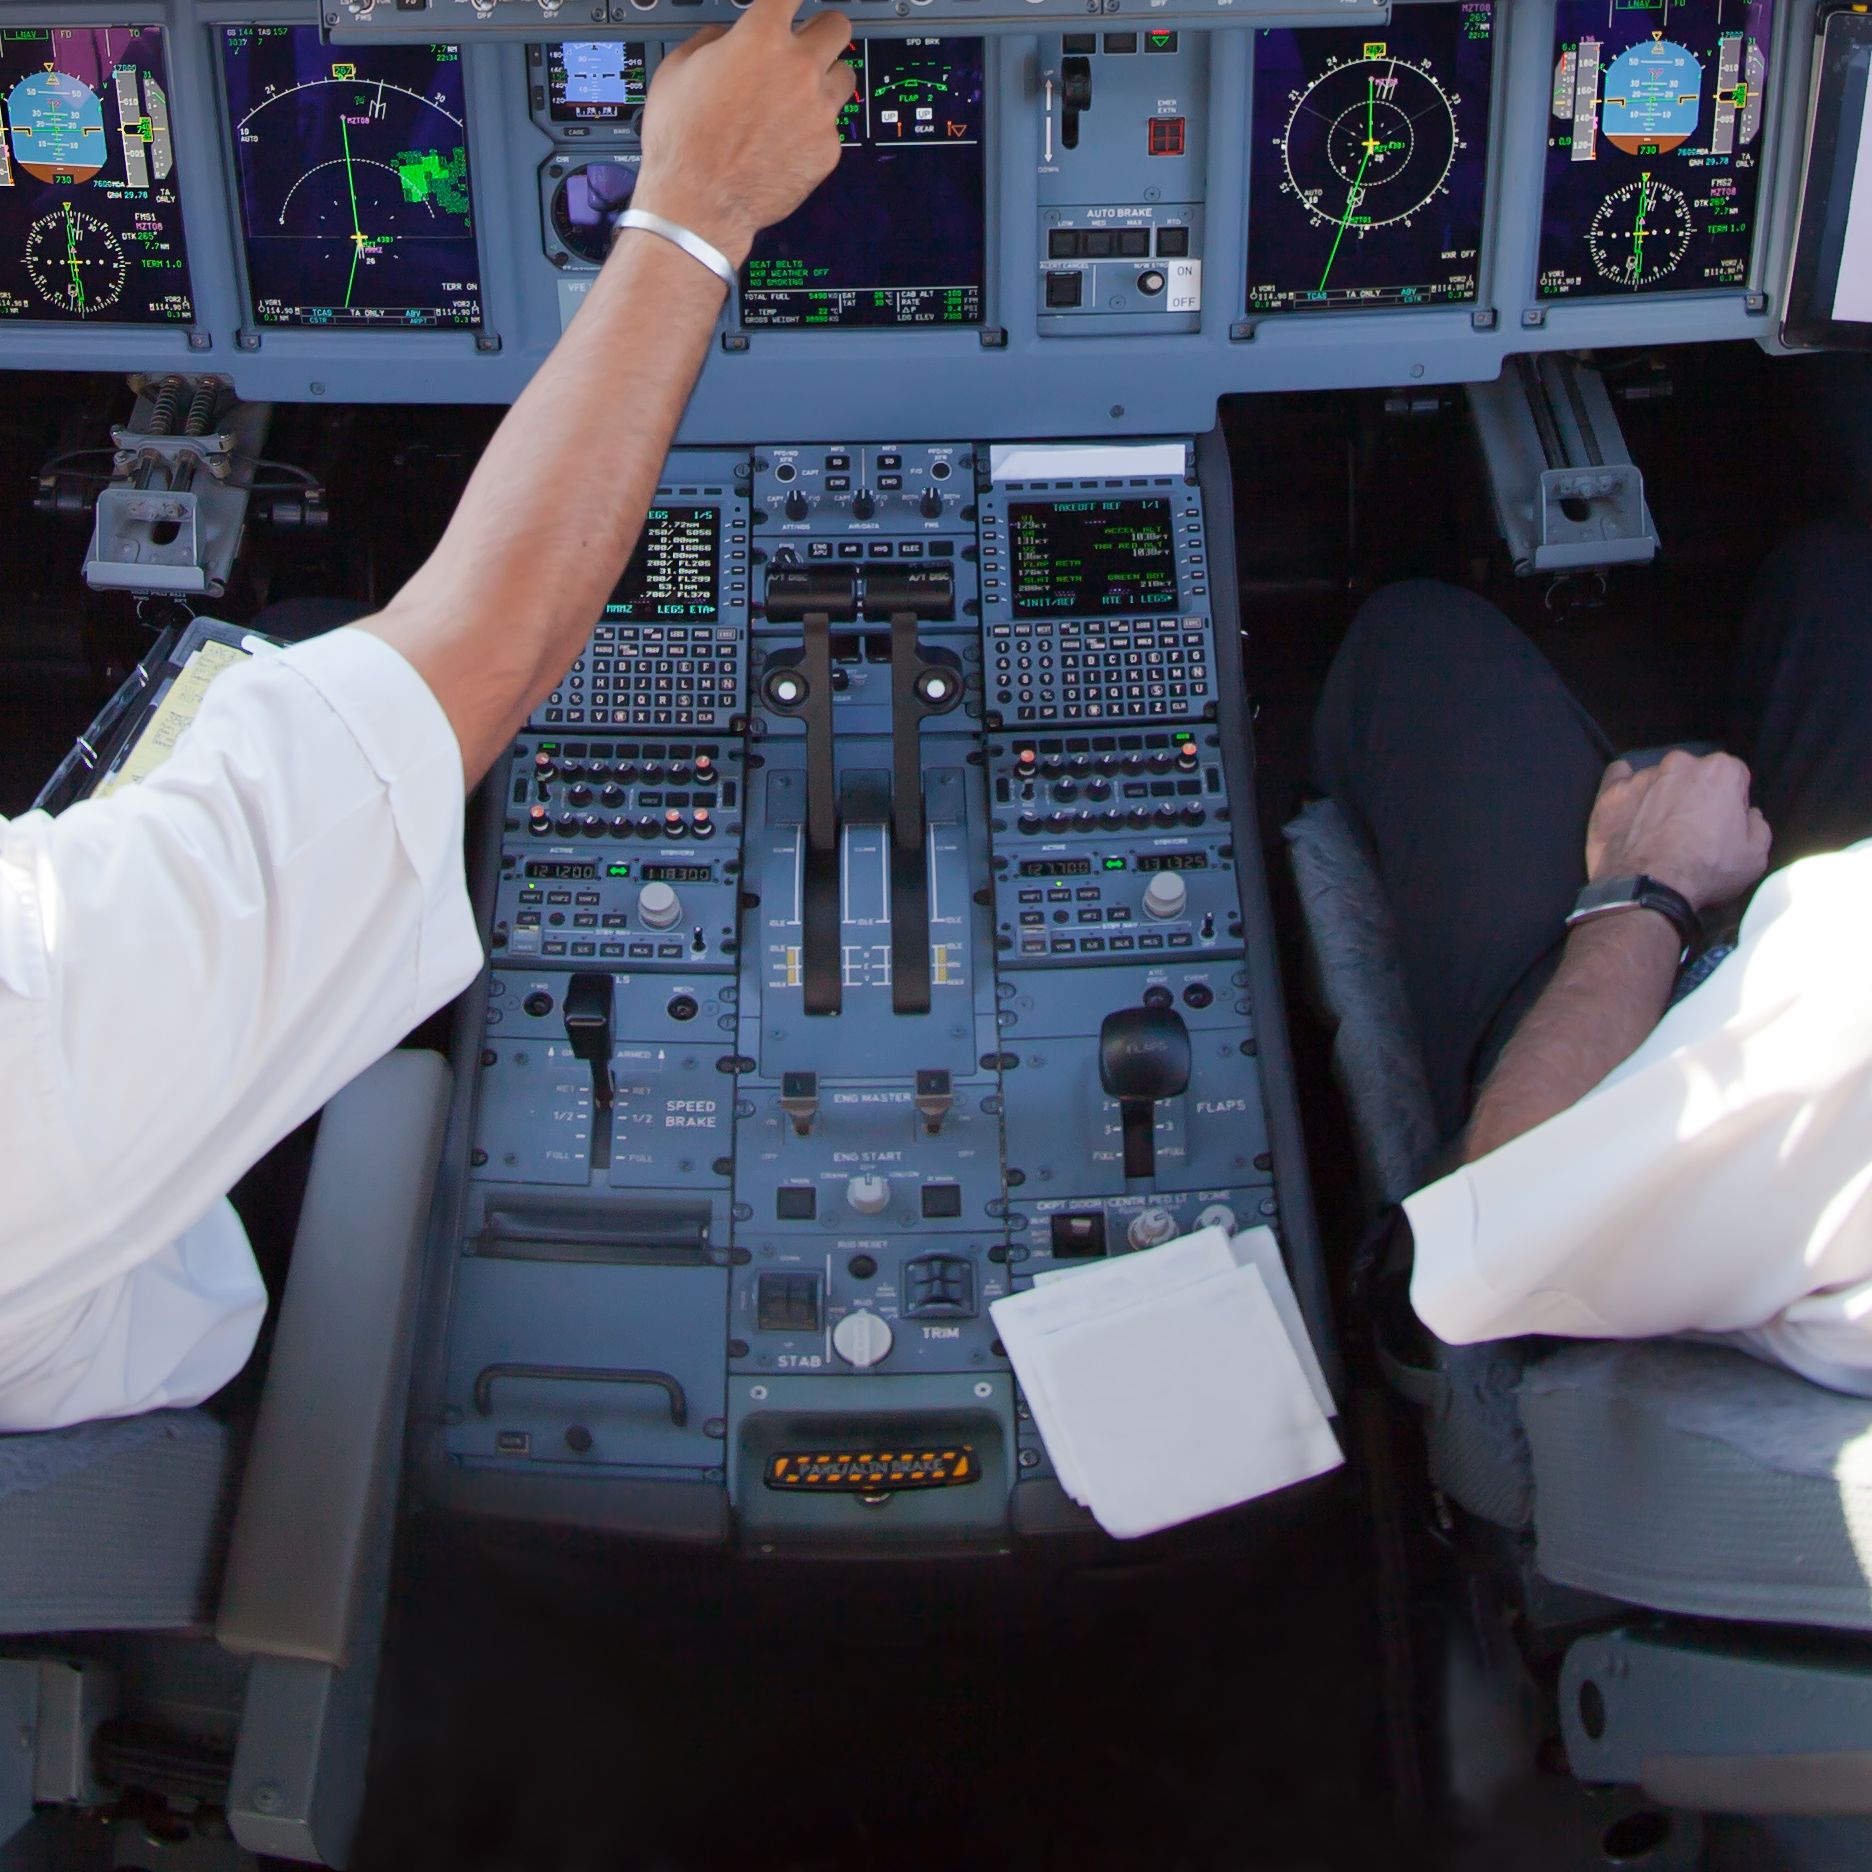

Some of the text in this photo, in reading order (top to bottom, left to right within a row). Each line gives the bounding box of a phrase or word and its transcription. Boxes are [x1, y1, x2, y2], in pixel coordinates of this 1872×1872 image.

[906, 38, 920, 46] SPD
[265, 84, 275, 94] 24
[435, 93, 445, 102] 30
[884, 113, 895, 121] UP
[919, 110, 931, 118] UP
[1640, 146, 1656, 154] 730
[56, 176, 72, 184] 730
[1711, 178, 1732, 186] FMS2
[135, 213, 156, 221] FMS1
[1087, 208, 1152, 217] AUTO BRAKE
[1708, 224, 1745, 233] TERM 1.0
[142, 260, 182, 268] TERM 1.0
[776, 260, 803, 268] BELTS
[1177, 266, 1192, 276] ON
[750, 278, 803, 286] NO SMOKING
[568, 283, 584, 291] VFE
[1346, 290, 1357, 298] TA
[1173, 297, 1195, 307] OFF
[772, 315, 800, 323] WEIGHT
[1054, 503, 1097, 511] TAKEOFF
[1142, 501, 1159, 509] 1/1
[1103, 596, 1121, 605] RTE
[1141, 594, 1167, 603] LEGS
[658, 605, 709, 614] LEGS ETA
[598, 662, 604, 670] A
[619, 662, 625, 670] B
[639, 662, 645, 670] C
[660, 662, 666, 670] D
[682, 662, 689, 671] E
[703, 662, 709, 670] F
[1000, 660, 1006, 668] 4
[597, 679, 604, 687] H
[640, 679, 645, 687] J
[660, 679, 666, 687] K
[681, 679, 687, 687] L
[702, 680, 710, 688] M
[1001, 676, 1007, 684] 7
[834, 1093, 911, 1103] ENG MASTER
[666, 1101, 716, 1111] SPEED
[1197, 1100, 1246, 1113] FLAPS
[554, 1112, 574, 1121] 1/2
[633, 1114, 653, 1122] 1/2
[665, 1117, 716, 1128] BRAKE
[629, 1155, 652, 1163] FULL
[834, 1151, 903, 1161] ENG START
[1071, 1199, 1101, 1210] DOOR
[922, 1328, 959, 1339] TRIM
[778, 1356, 821, 1367] STAB
